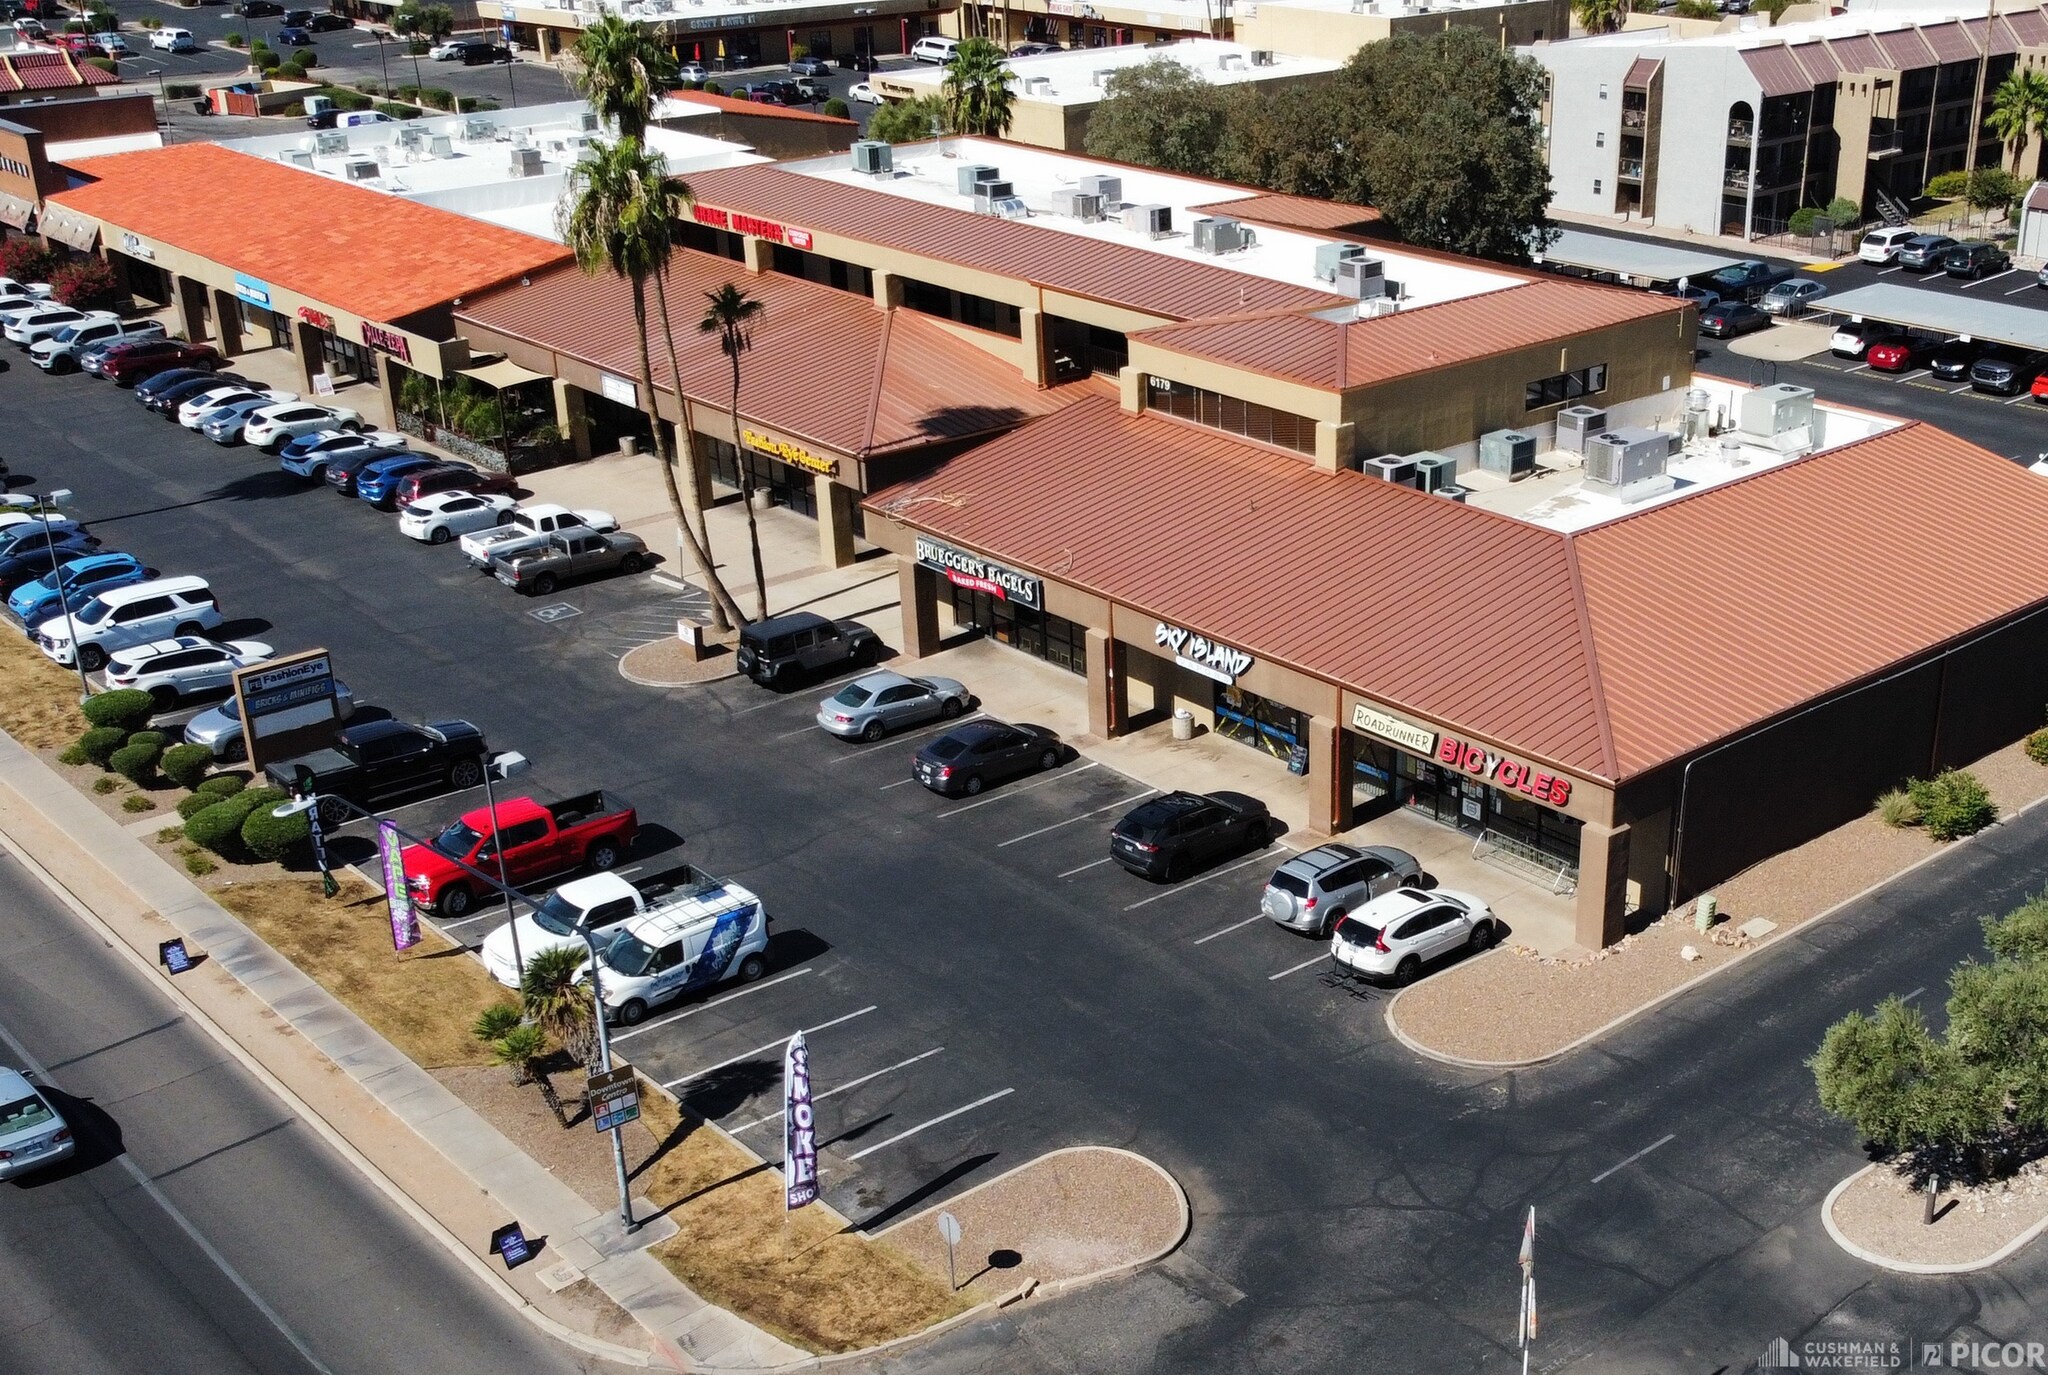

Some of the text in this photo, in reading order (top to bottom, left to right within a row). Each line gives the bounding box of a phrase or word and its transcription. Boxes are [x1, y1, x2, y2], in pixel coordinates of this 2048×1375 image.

[1150, 376, 1170, 391] 6179
[915, 539, 1034, 602] BRUEGGER'S BAGELS
[952, 574, 997, 594] BAKED FRESH
[1155, 622, 1252, 675] SKY ISLAND
[262, 662, 323, 684] FashionEye
[1356, 709, 1571, 806] ROADRUNNER BICYCLES
[590, 1077, 634, 1098] Downtown
[601, 1087, 628, 1102] Centro
[789, 1188, 815, 1204] SHO
